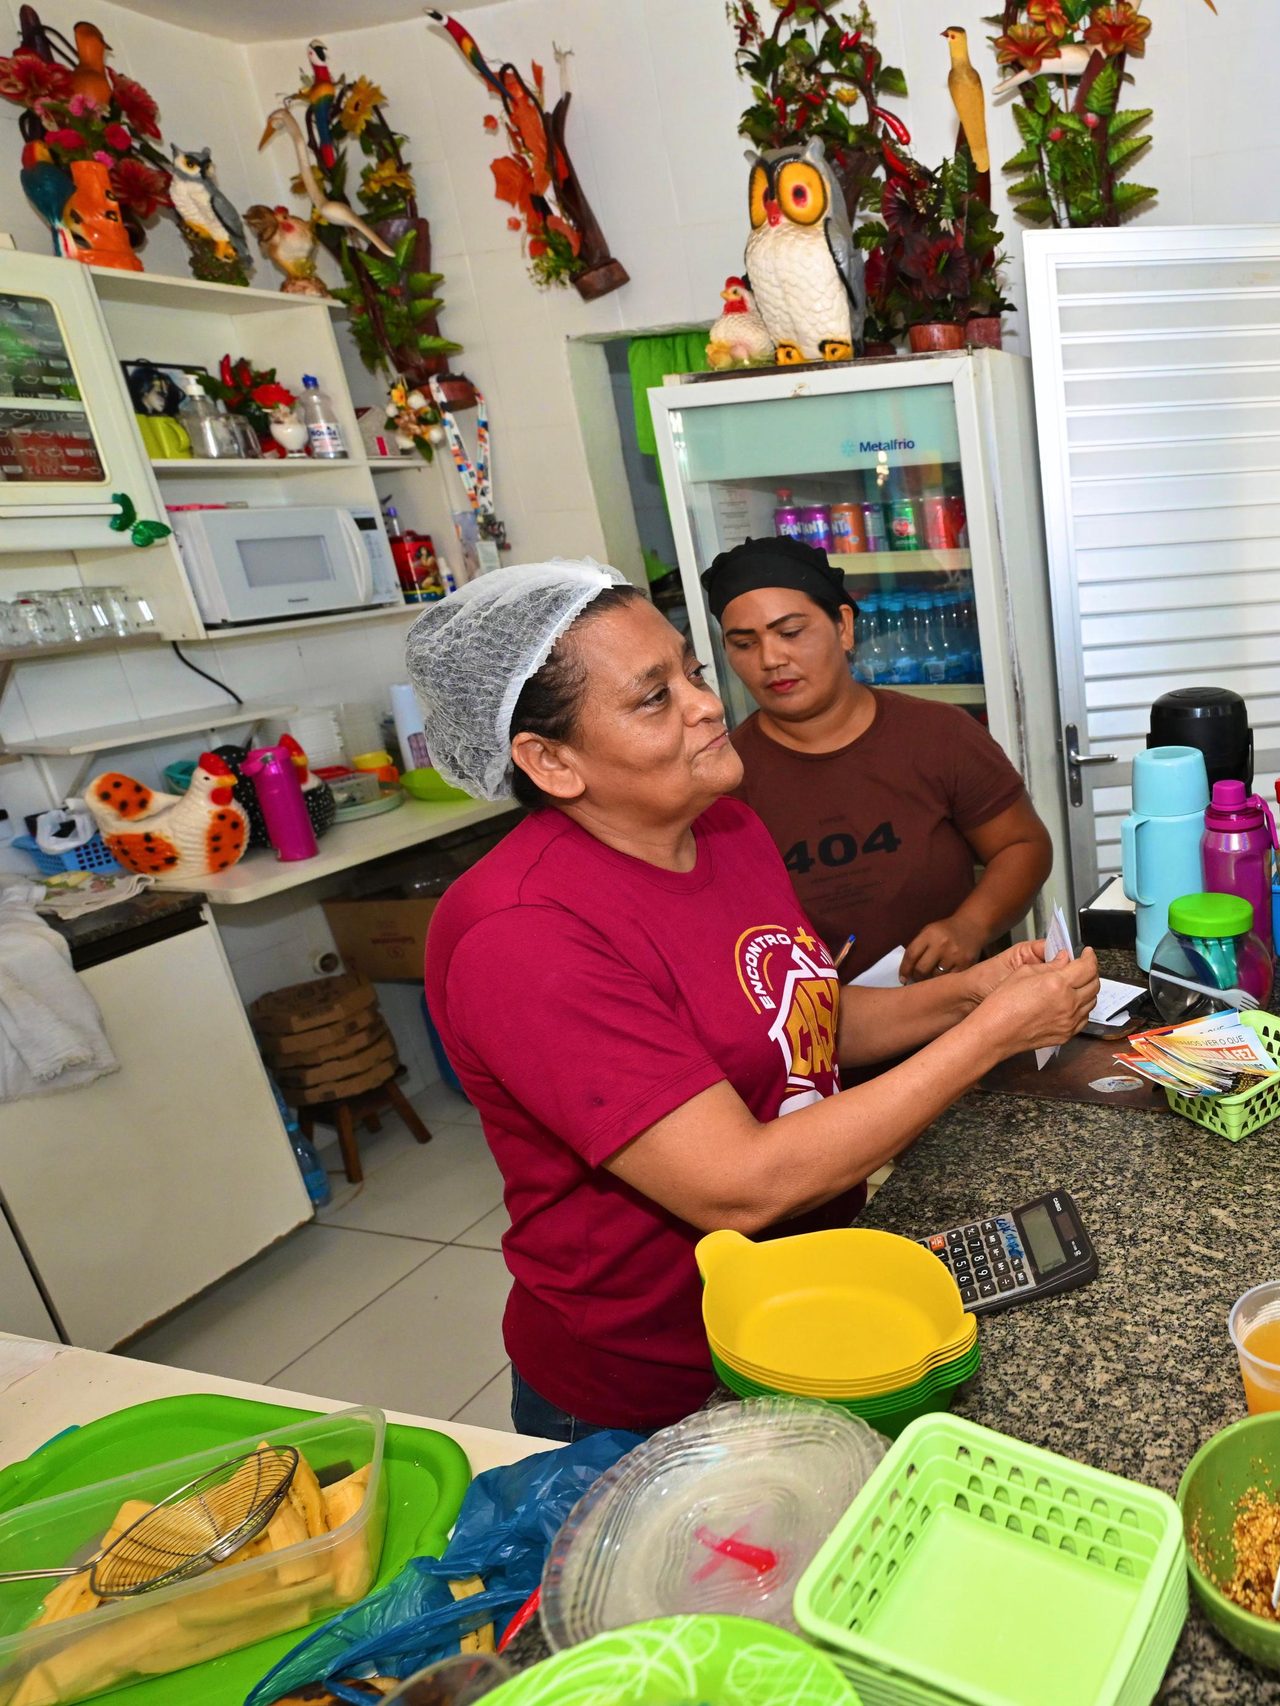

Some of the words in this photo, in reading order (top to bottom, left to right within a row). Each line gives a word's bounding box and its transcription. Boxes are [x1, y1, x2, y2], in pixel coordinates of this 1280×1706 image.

[859, 438, 915, 453] Metalfrio
[783, 821, 902, 874] 404
[745, 933, 791, 1010] ENCONTRO
[1205, 1039, 1218, 1047] VER
[1227, 1034, 1245, 1045] QUE
[1231, 1047, 1256, 1060] FEZ
[1052, 1197, 1062, 1212] CASIO
[974, 1254, 985, 1262] 8
